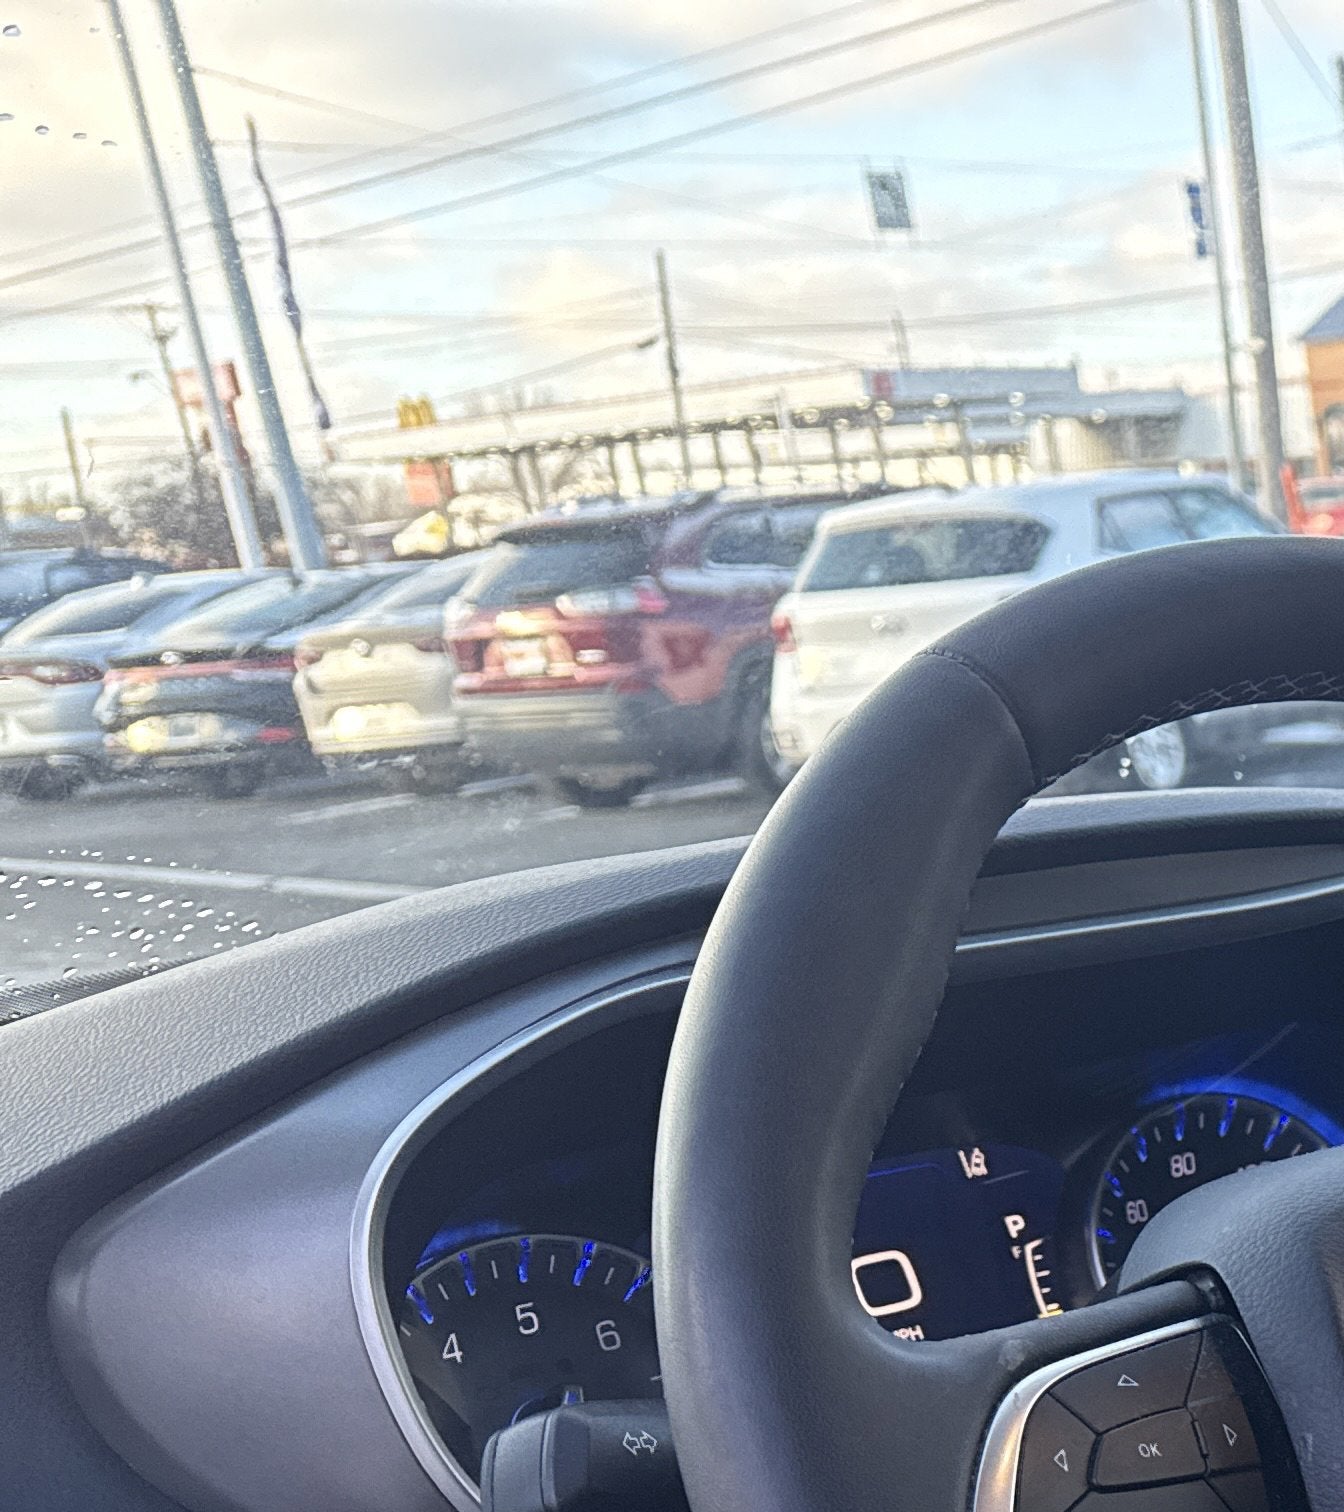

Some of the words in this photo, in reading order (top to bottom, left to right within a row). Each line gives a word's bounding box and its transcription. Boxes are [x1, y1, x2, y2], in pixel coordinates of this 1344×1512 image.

[1170, 1151, 1196, 1178] 80
[1125, 1199, 1149, 1224] 60
[1003, 1213, 1027, 1239] P
[514, 1302, 539, 1336] 5
[441, 1332, 463, 1364] 4
[595, 1319, 621, 1351] 6
[1137, 1442, 1163, 1458] OK
